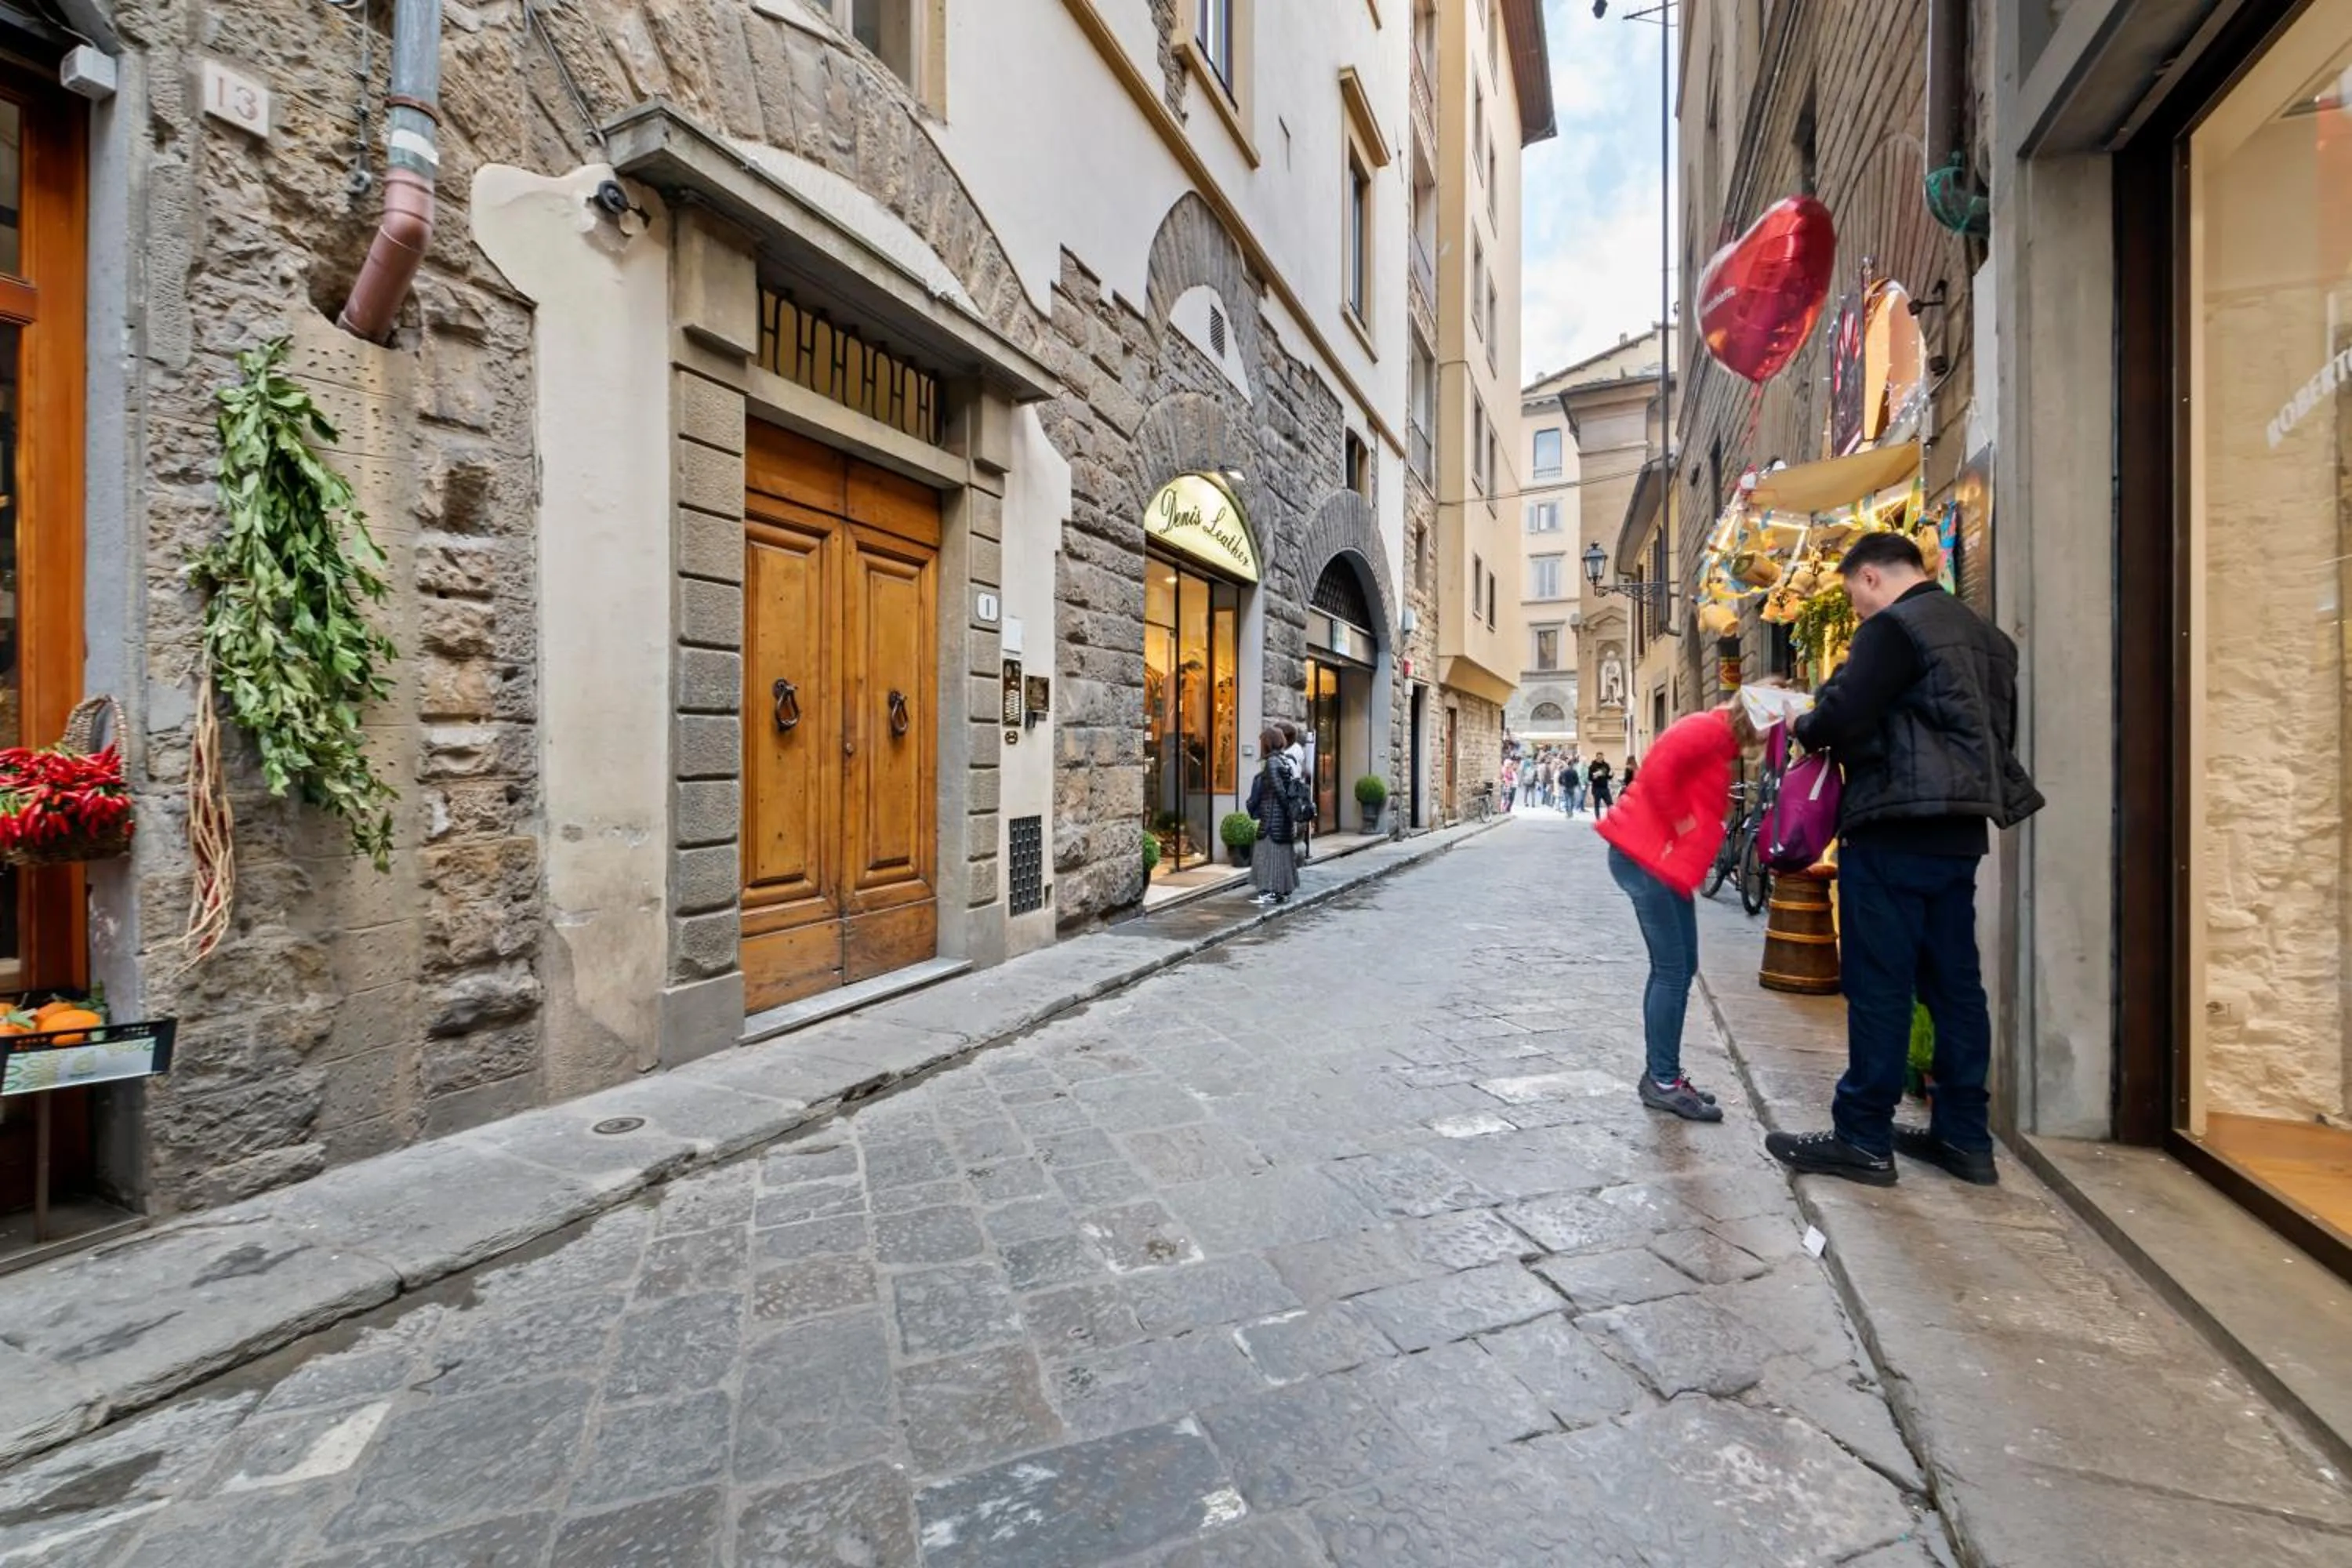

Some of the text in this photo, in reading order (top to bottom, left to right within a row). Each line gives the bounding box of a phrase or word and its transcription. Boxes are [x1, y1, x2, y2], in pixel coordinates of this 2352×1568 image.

[217, 76, 259, 121] 13
[1158, 488, 1249, 567] Denis Leather
